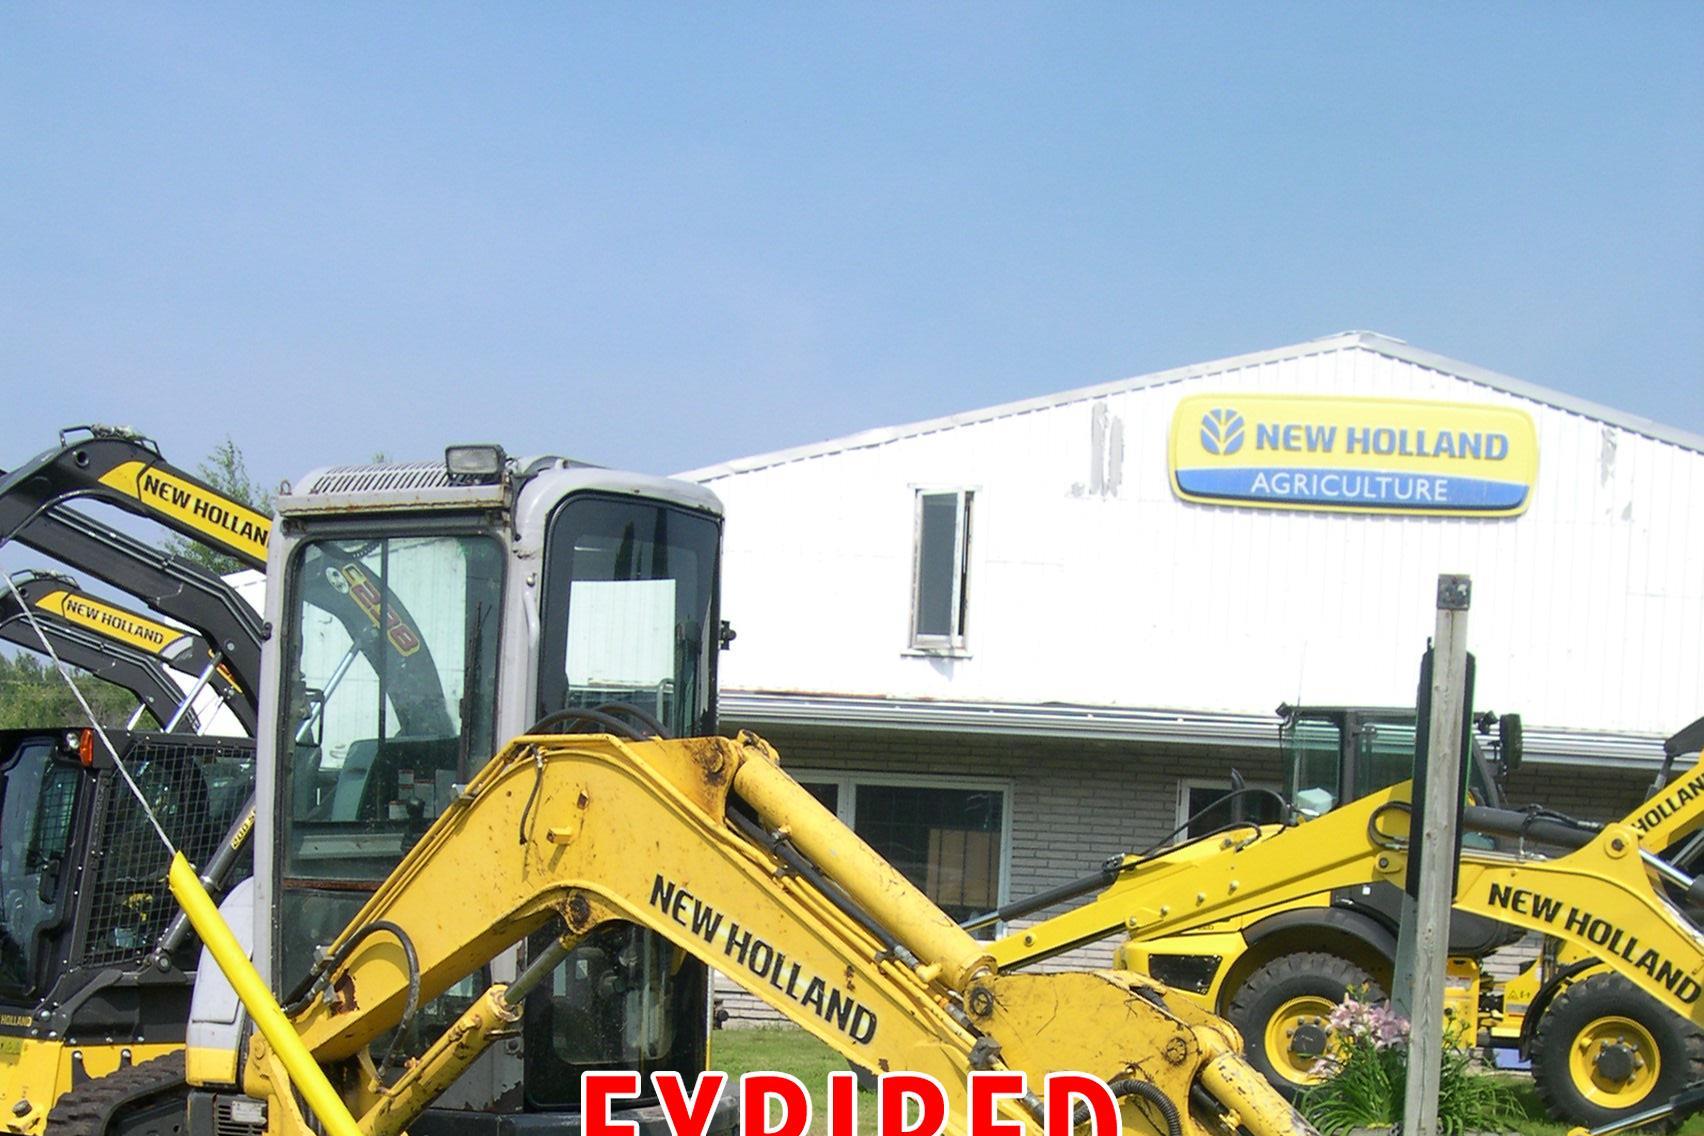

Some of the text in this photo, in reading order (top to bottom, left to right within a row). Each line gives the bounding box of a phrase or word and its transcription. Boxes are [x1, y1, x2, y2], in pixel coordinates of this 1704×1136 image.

[1256, 423, 1509, 461] NEW HOLLAND
[143, 474, 269, 549] NEW HOLLAN
[1250, 471, 1449, 501] AGRICULTURE
[66, 600, 163, 645] NEW HOLLAND
[1631, 772, 1704, 840] HOLLAN
[650, 874, 877, 1045] NEW HOLLAND
[1488, 883, 1702, 1004] NEW HOLLAND
